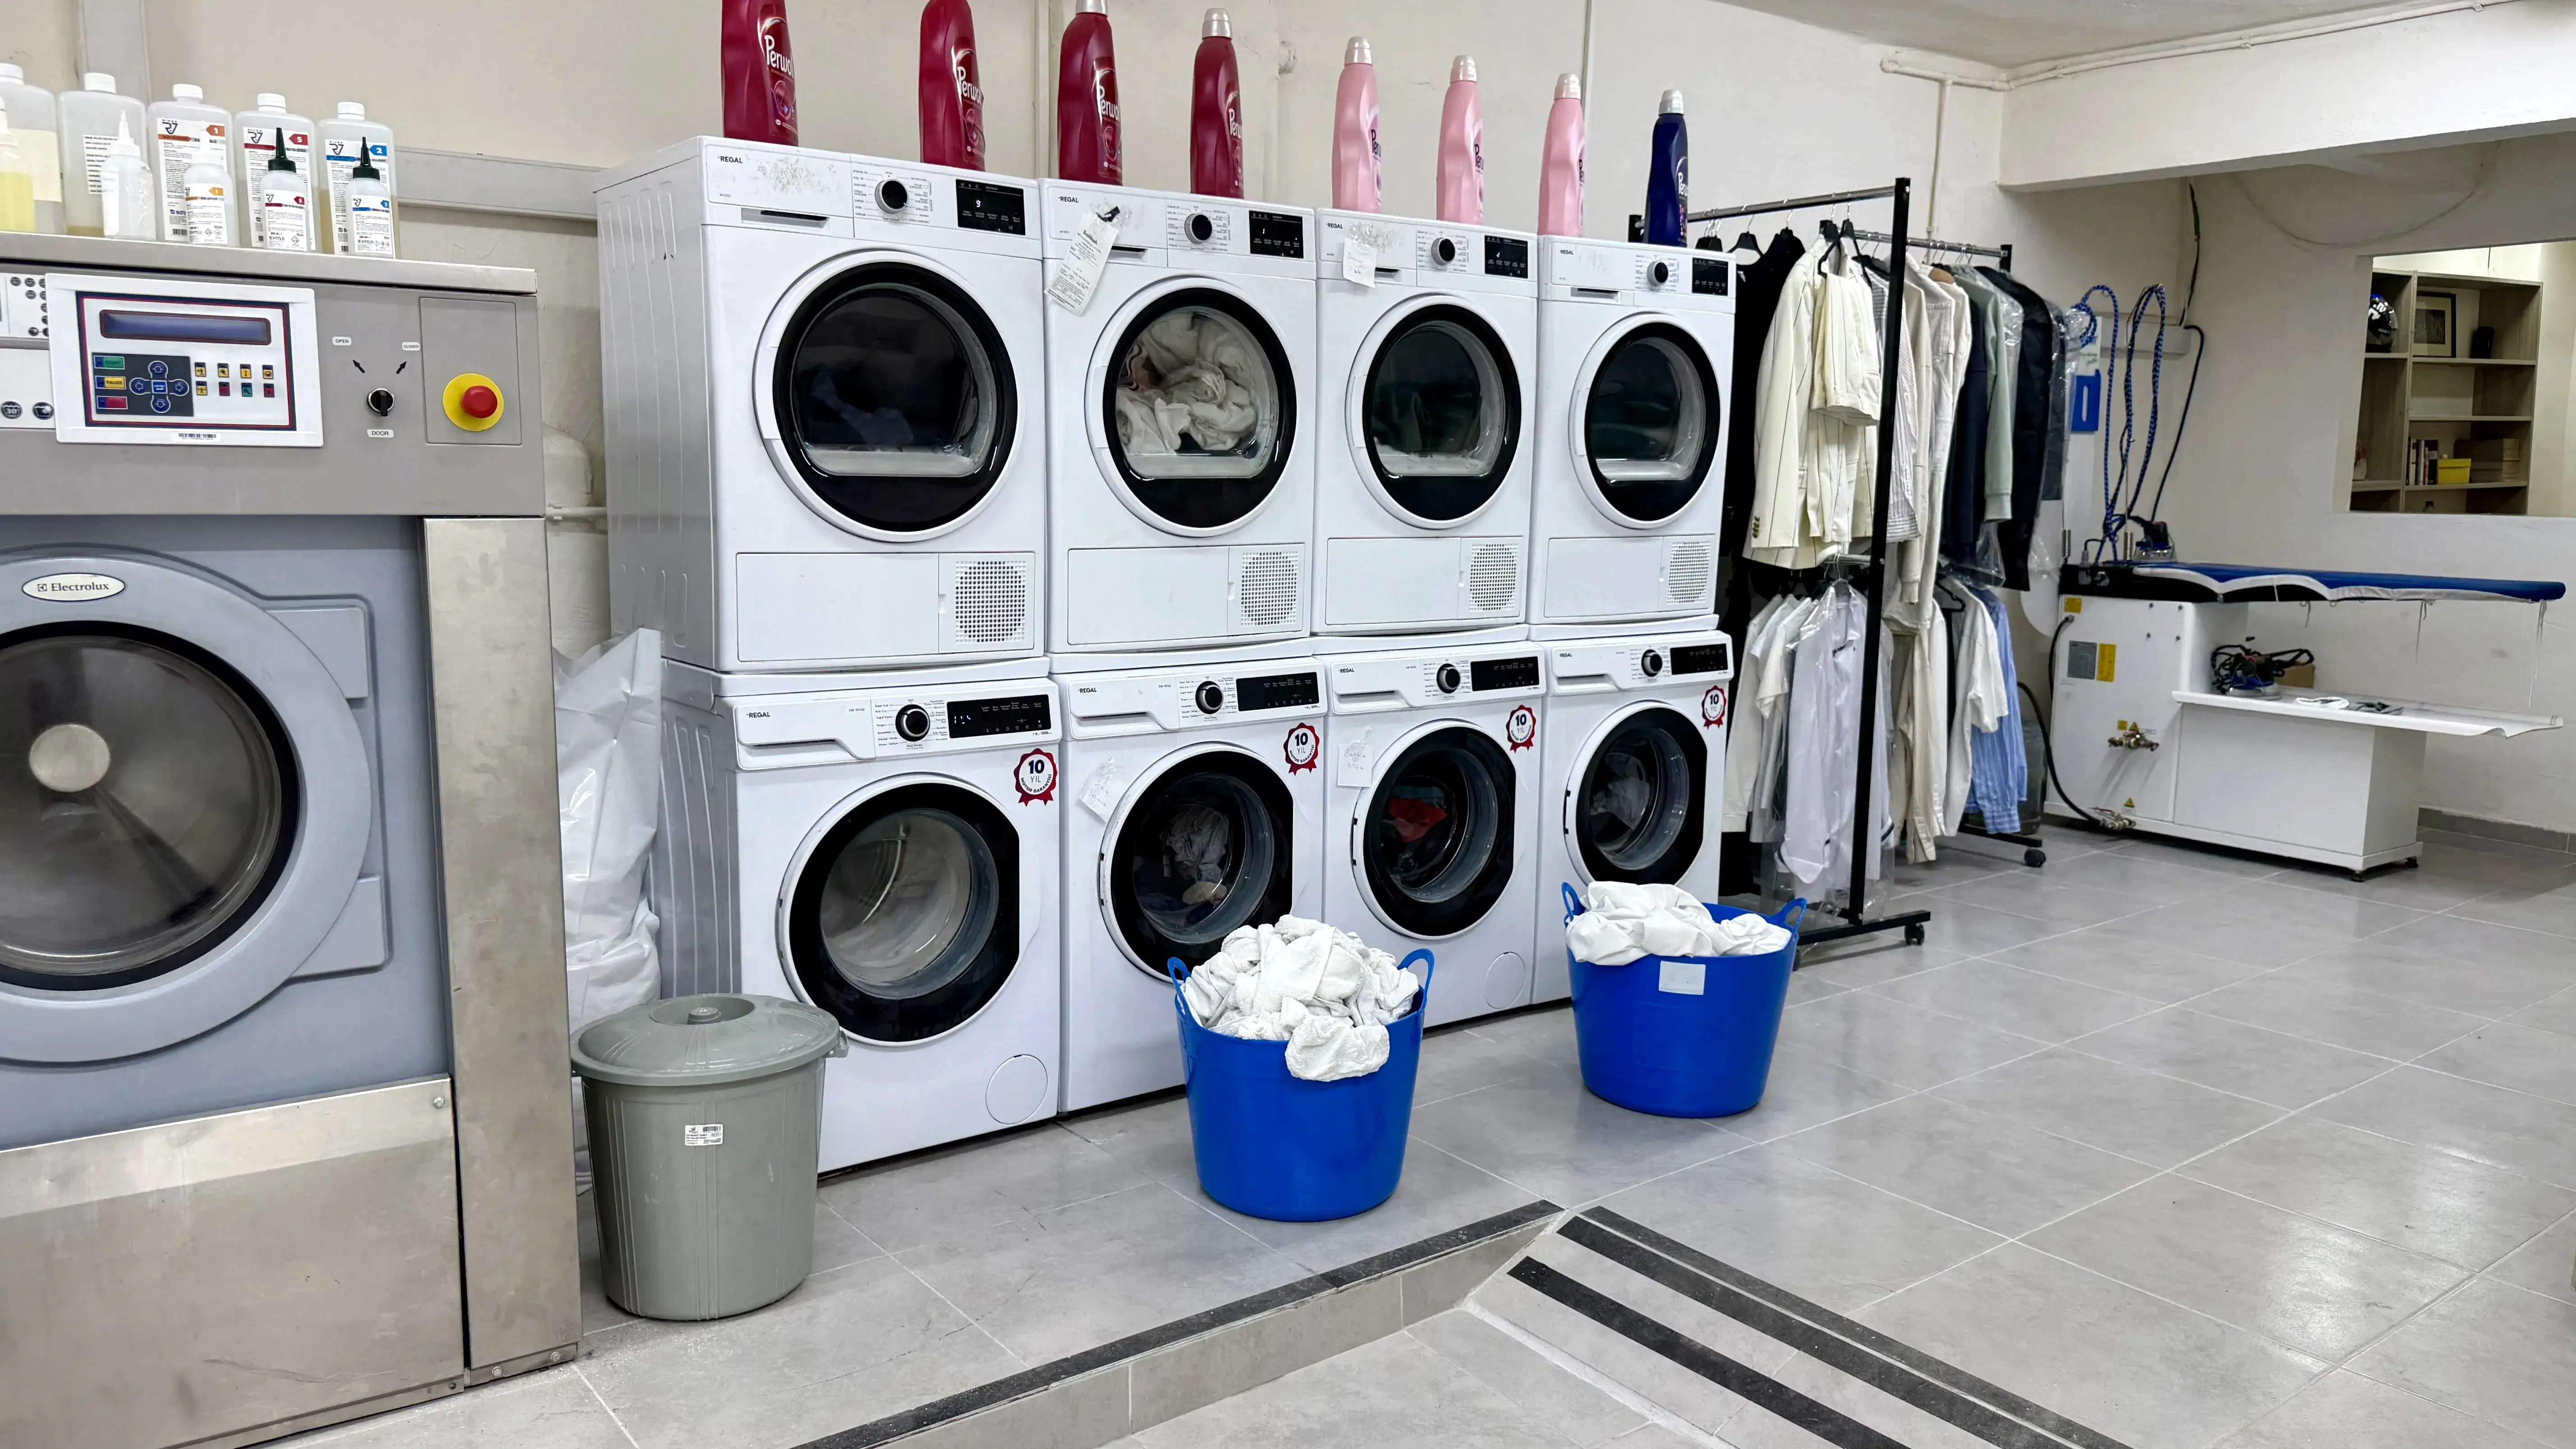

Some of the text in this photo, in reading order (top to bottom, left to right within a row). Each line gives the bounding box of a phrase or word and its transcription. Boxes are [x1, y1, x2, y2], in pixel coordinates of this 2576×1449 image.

[51, 582, 110, 592] Electrolux
[1710, 694, 1719, 705] 10
[1516, 713, 1527, 726] 10
[1295, 732, 1308, 746] 10
[1029, 759, 1044, 774] 10
[1021, 777, 1032, 792] MOTOR
